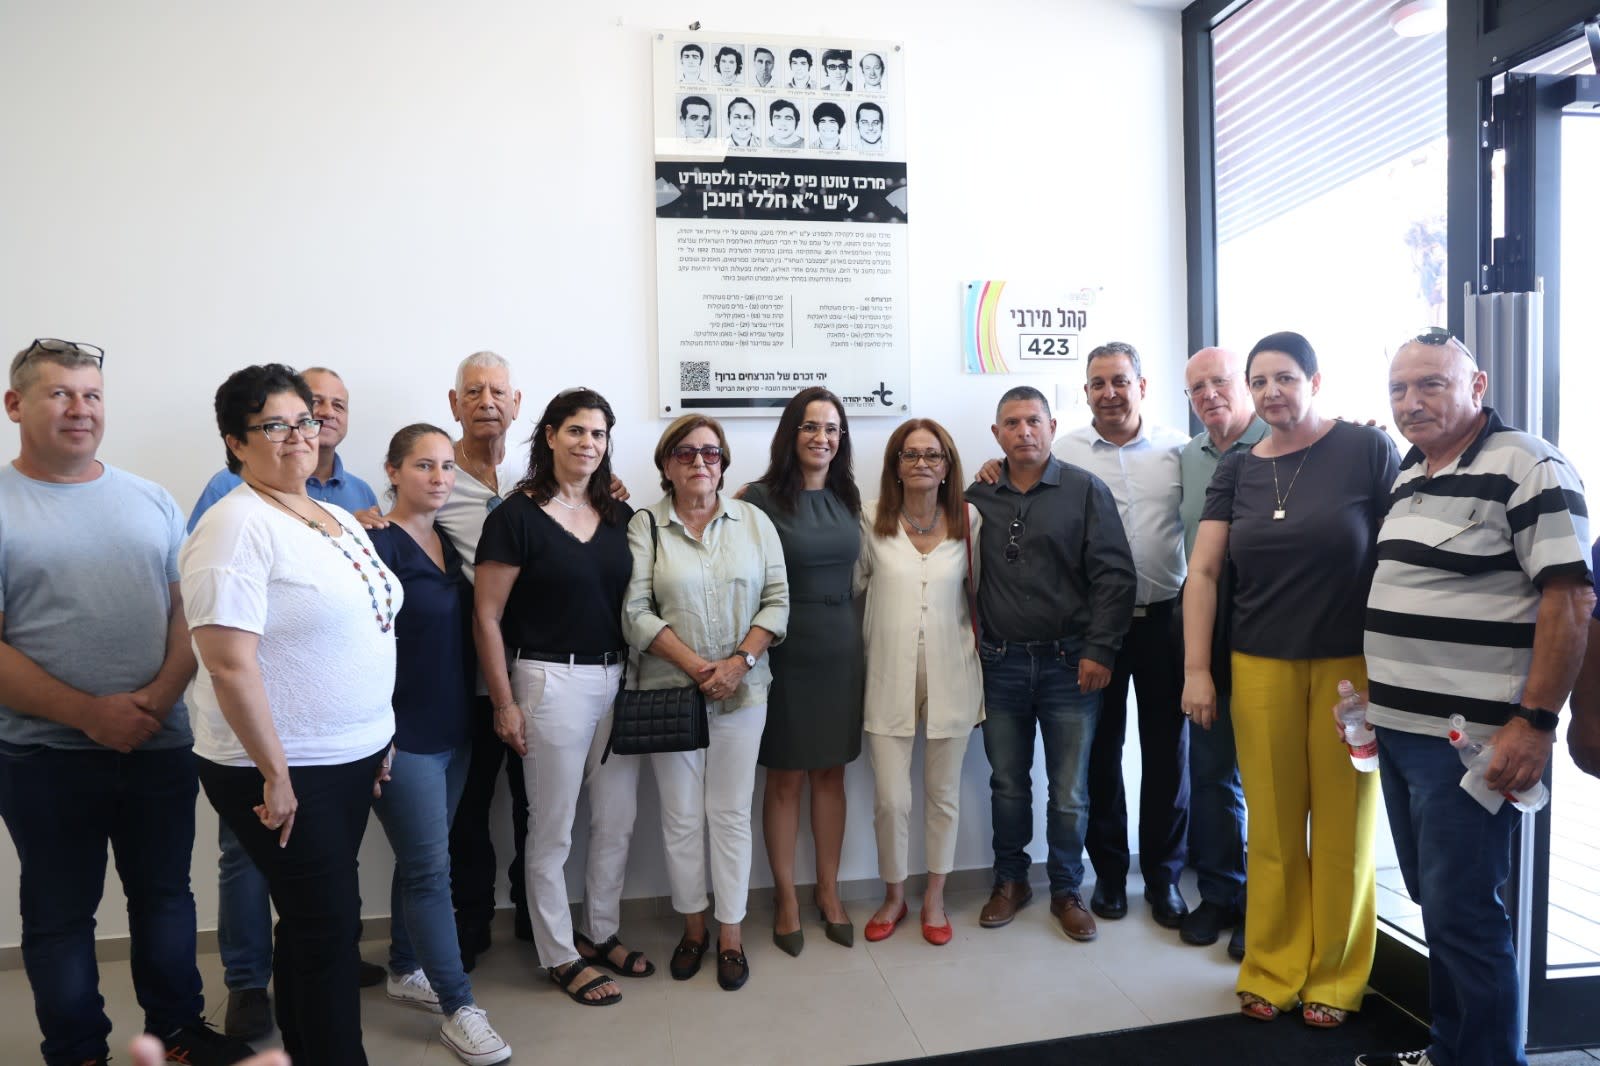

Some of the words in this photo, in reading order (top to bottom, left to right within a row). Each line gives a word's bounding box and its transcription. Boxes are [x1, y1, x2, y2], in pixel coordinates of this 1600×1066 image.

[678, 168, 735, 184] ולספורט
[739, 170, 790, 188] לקהילה
[794, 174, 817, 186] פיס
[820, 175, 849, 188] טוטו
[852, 176, 885, 189] מרכז
[703, 191, 743, 210] מינכן
[748, 189, 786, 208] חללי
[792, 193, 818, 208] י"א
[823, 194, 858, 211] ע"ש
[1010, 309, 1052, 328] מירבי
[1056, 308, 1087, 331] קהל
[1028, 338, 1069, 356] 423
[715, 373, 735, 382] ברוך!
[738, 372, 774, 380] הנרצחים
[777, 370, 790, 380] של
